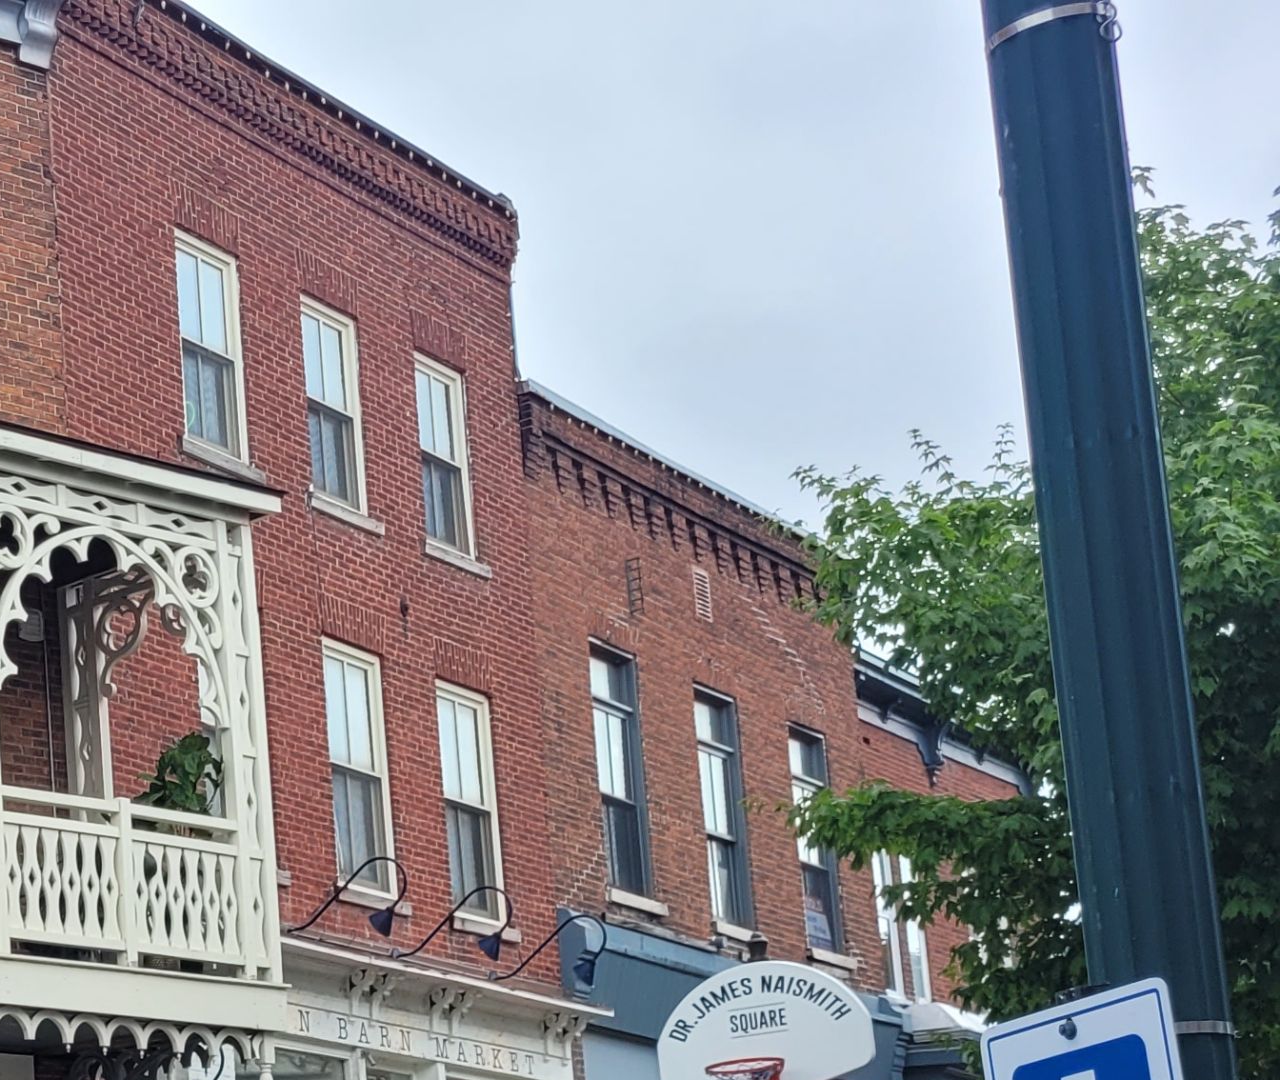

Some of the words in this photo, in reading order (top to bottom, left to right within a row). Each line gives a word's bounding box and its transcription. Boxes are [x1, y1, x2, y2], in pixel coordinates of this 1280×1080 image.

[693, 977, 752, 1019] JAMES
[760, 975, 852, 1021] NAISMITH
[730, 1008, 787, 1034] SQUARE
[337, 1017, 411, 1052] BARN
[435, 1036, 534, 1075] MARKET
